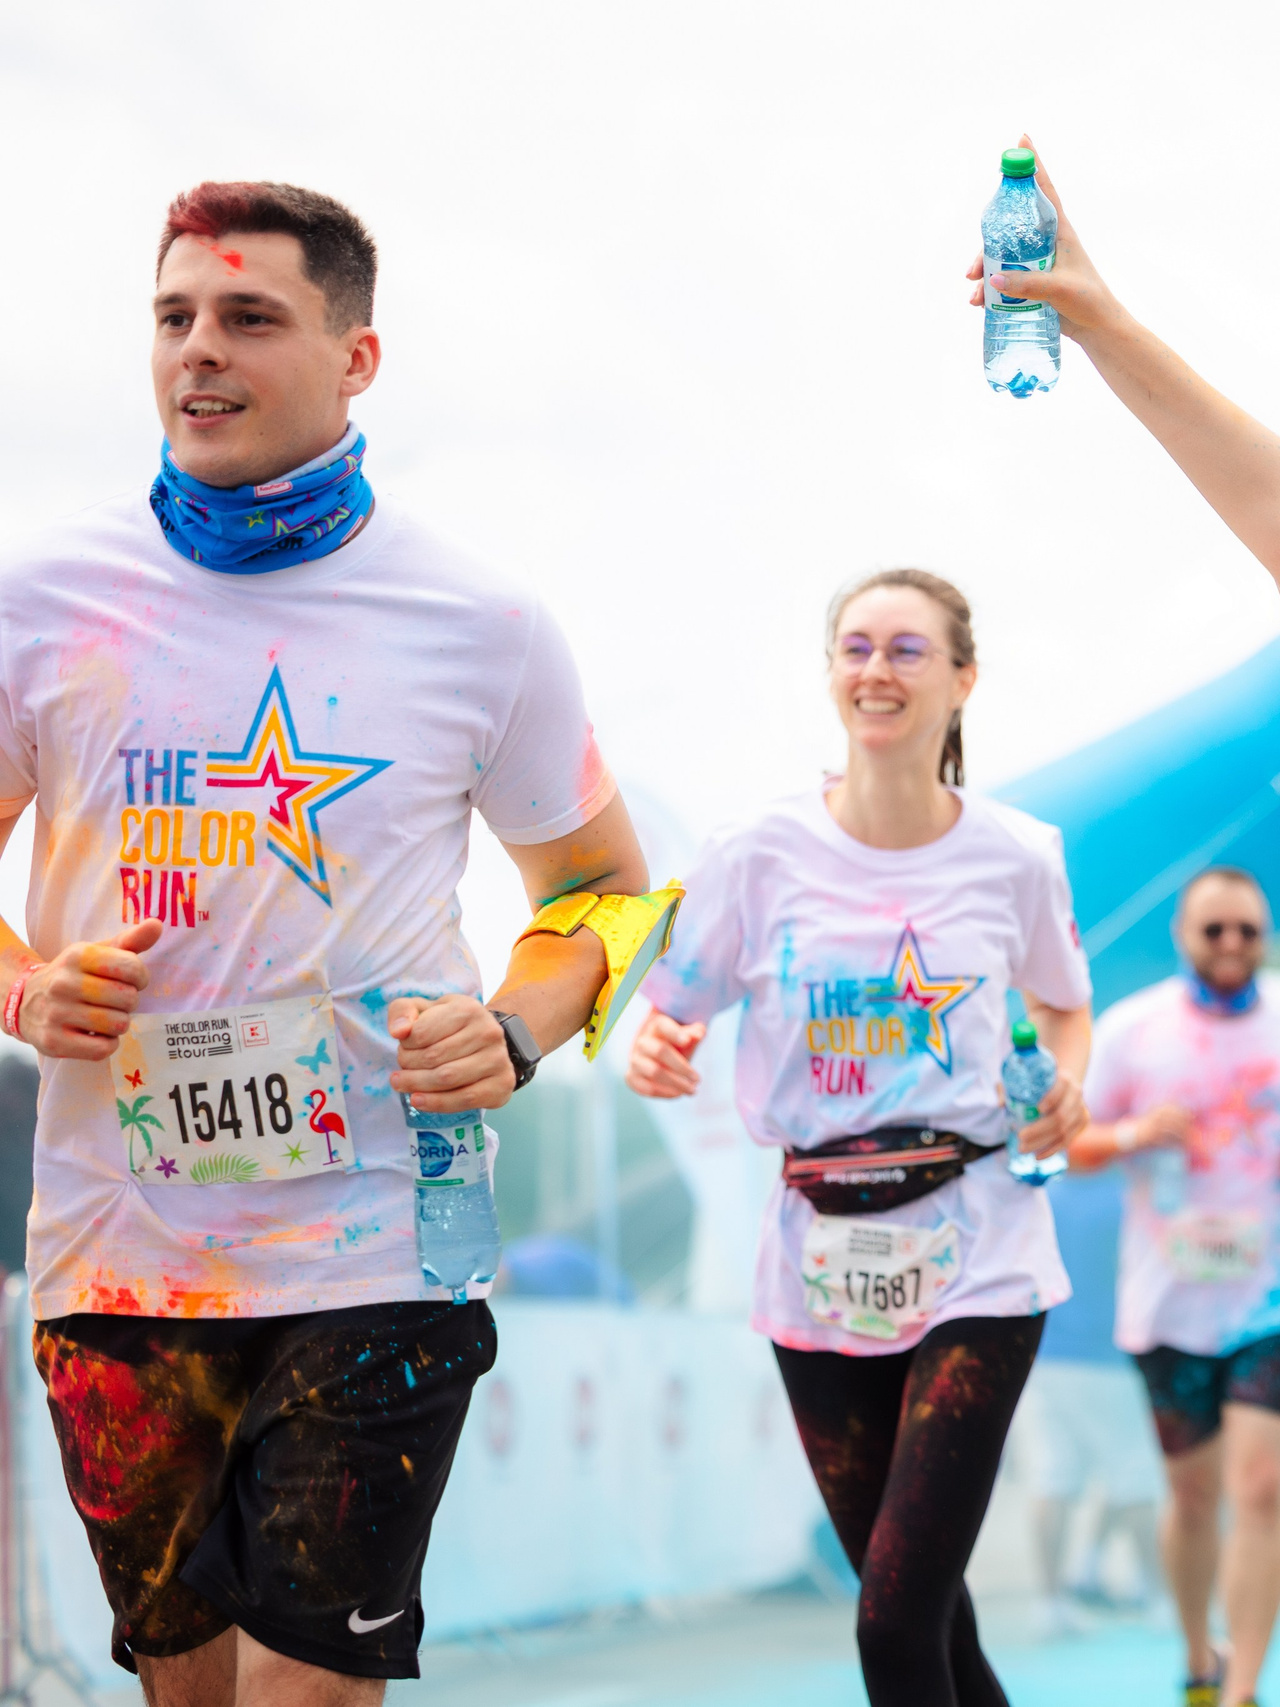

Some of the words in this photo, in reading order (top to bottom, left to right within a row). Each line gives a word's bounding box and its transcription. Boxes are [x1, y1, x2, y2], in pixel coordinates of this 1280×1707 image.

[119, 749, 197, 806] THE
[119, 808, 256, 867] COLOR
[804, 980, 861, 1018] THE
[165, 1023, 181, 1034] THE
[181, 1020, 211, 1034] COLOR
[166, 1032, 231, 1046] amazing
[807, 1016, 905, 1056] COLOR
[177, 1048, 206, 1059] tour
[168, 1072, 293, 1144] 15418
[410, 1143, 469, 1158] DORNA
[844, 1266, 922, 1311] 17587
